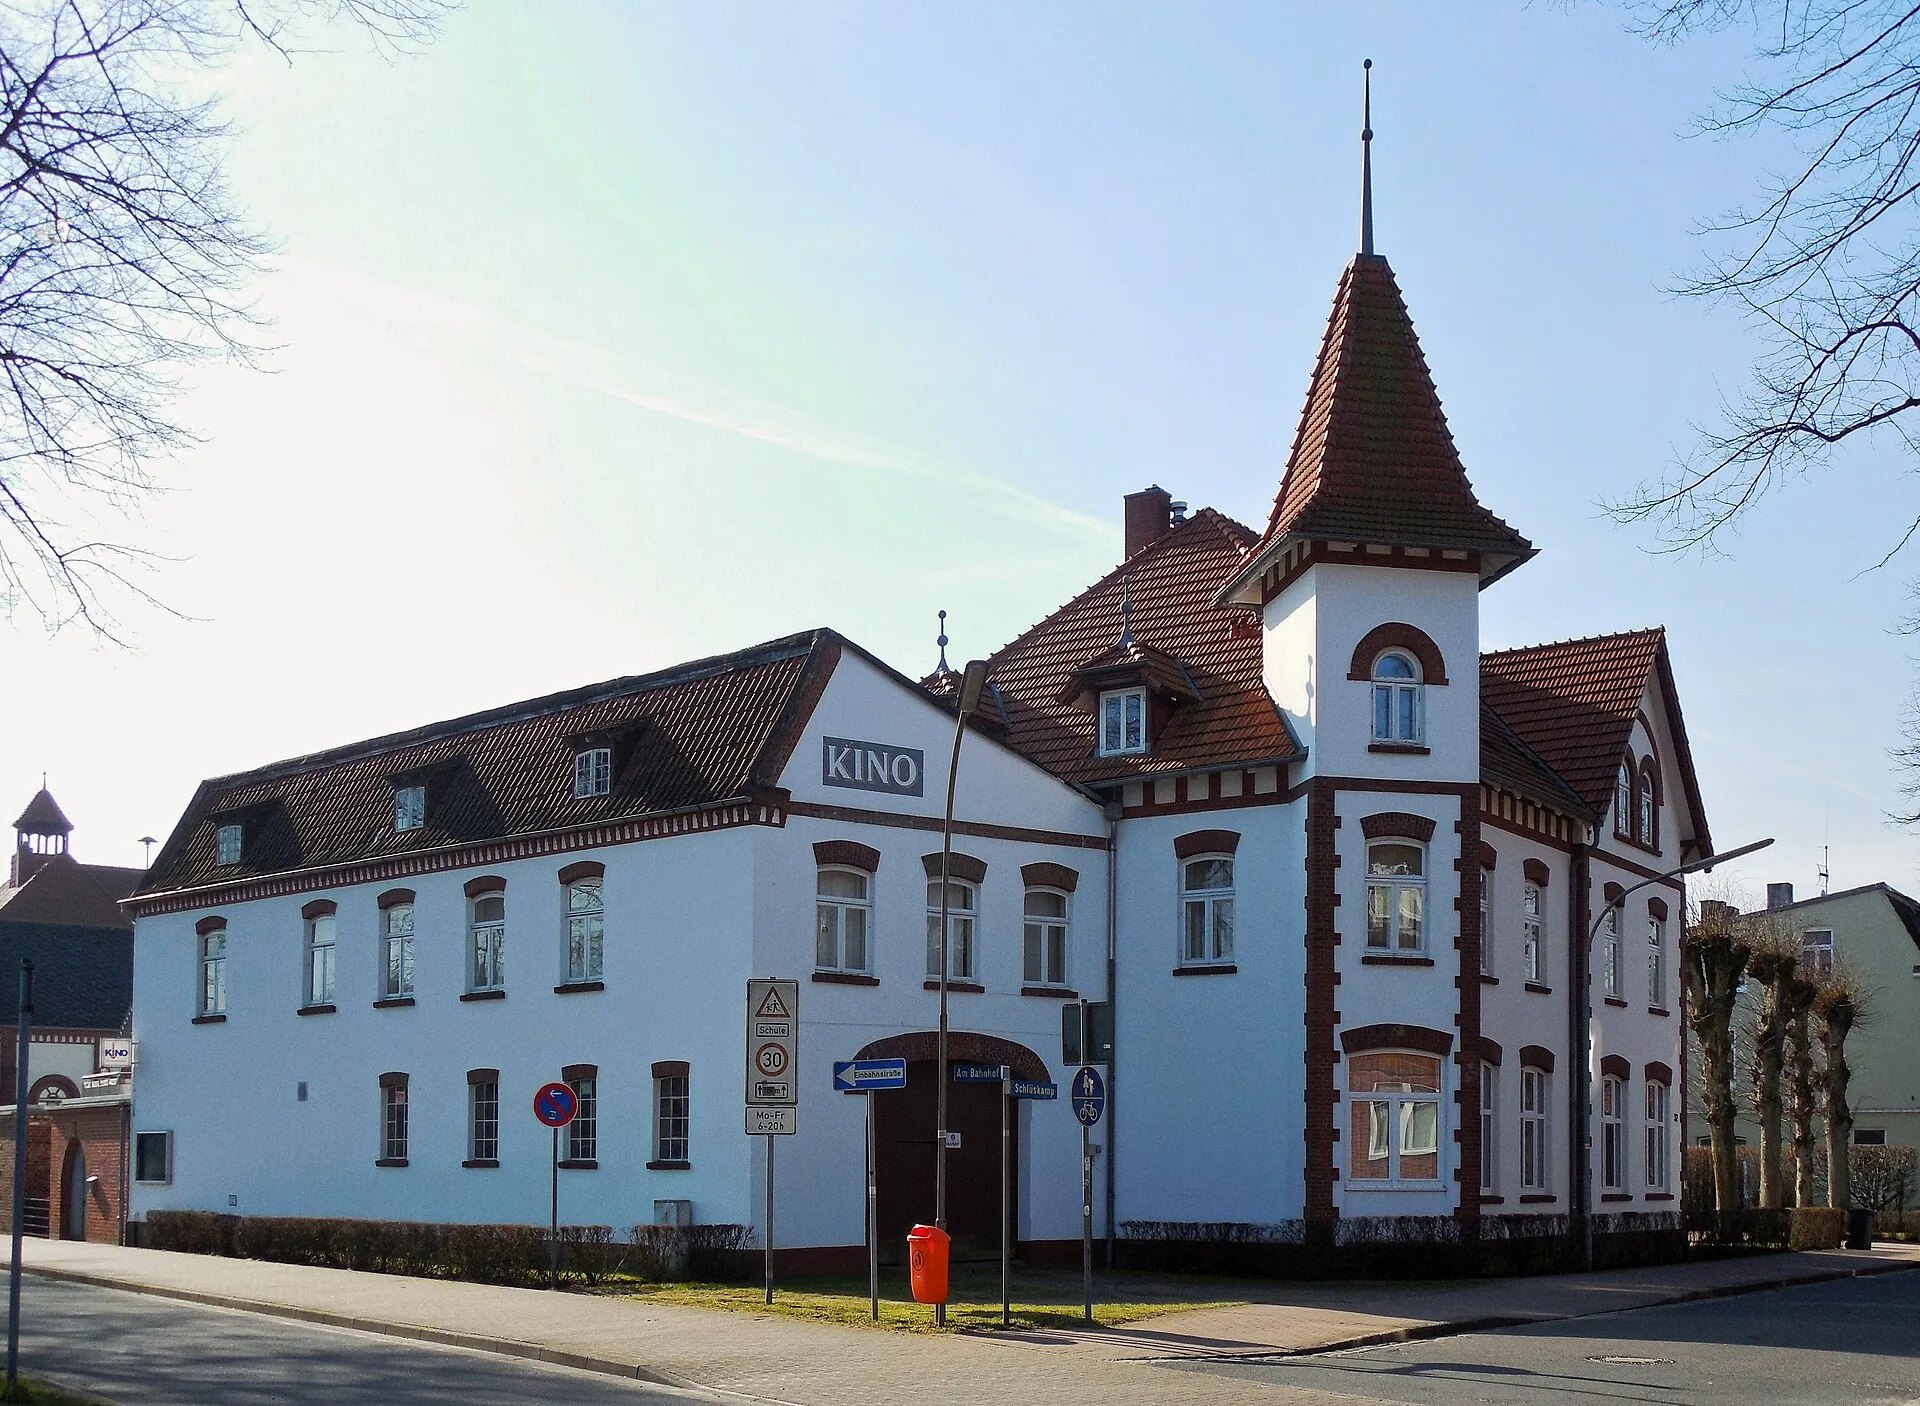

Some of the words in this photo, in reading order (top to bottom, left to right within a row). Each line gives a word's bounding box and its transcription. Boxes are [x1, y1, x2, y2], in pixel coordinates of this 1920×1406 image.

[828, 744, 917, 787] KINO
[760, 1026, 786, 1034] Schule
[763, 1052, 782, 1068] 30
[854, 1069, 902, 1079] Einbahnstraße
[956, 1067, 968, 1078] Am
[970, 1067, 1000, 1078] Bahnhof
[1014, 1083, 1055, 1098] Schlüskamp
[756, 1110, 785, 1120] Mo-Fr
